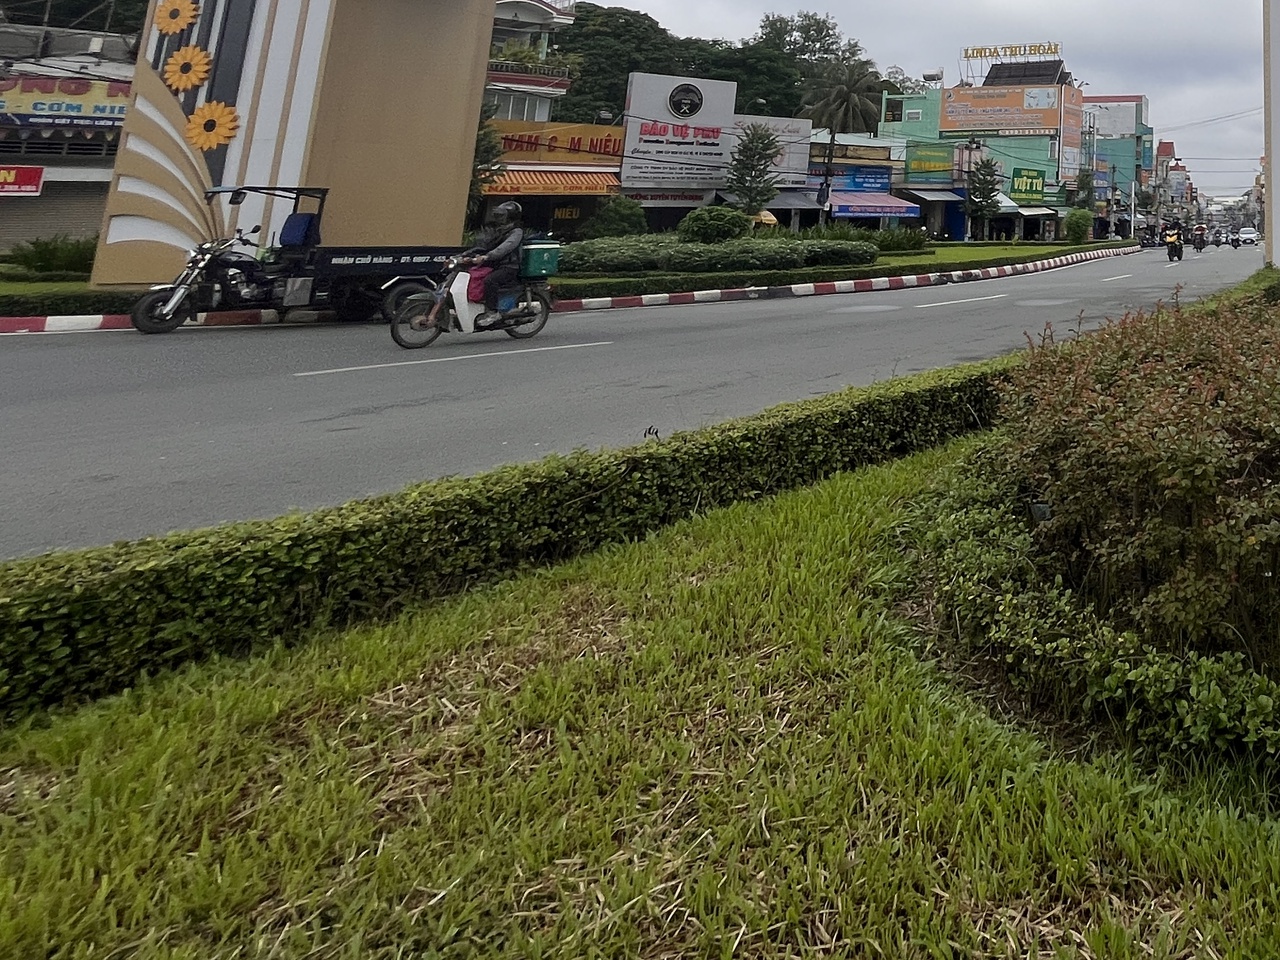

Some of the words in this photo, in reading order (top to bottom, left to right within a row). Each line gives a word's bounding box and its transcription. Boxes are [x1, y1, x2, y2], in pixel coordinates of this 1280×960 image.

[964, 46, 1000, 59] LINDA
[1001, 44, 1026, 57] THU
[32, 100, 83, 114] CƠM
[640, 120, 669, 137] BẢO
[672, 122, 690, 140] VỆ
[502, 133, 541, 152] NAM
[588, 132, 622, 155] NIÊU
[1014, 176, 1032, 192] VIỆT
[1032, 177, 1043, 191] TÚ
